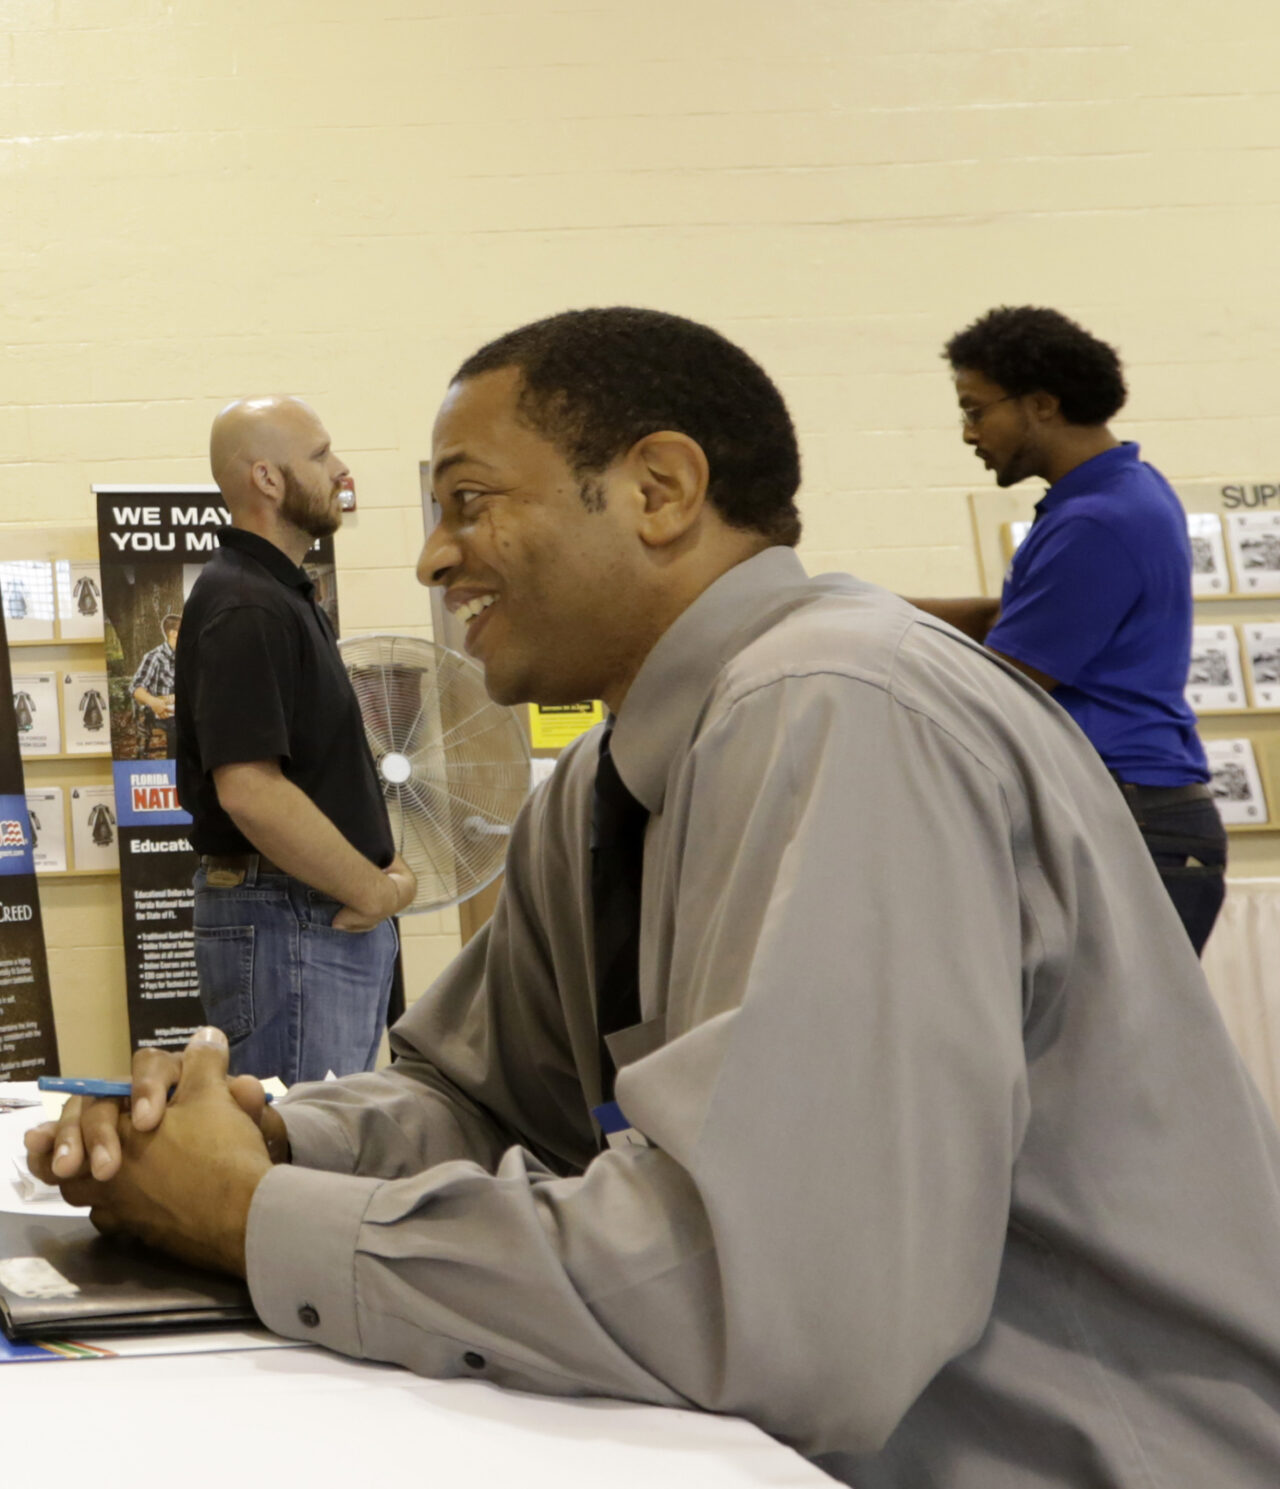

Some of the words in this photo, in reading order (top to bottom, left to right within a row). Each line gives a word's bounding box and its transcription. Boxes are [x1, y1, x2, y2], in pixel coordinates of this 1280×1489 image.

[1222, 484, 1280, 509] SUP
[112, 506, 162, 526] WE
[171, 506, 232, 526] MAY
[110, 532, 176, 551] YOU
[131, 774, 169, 785] FLORIDA
[131, 838, 194, 853] Educati
